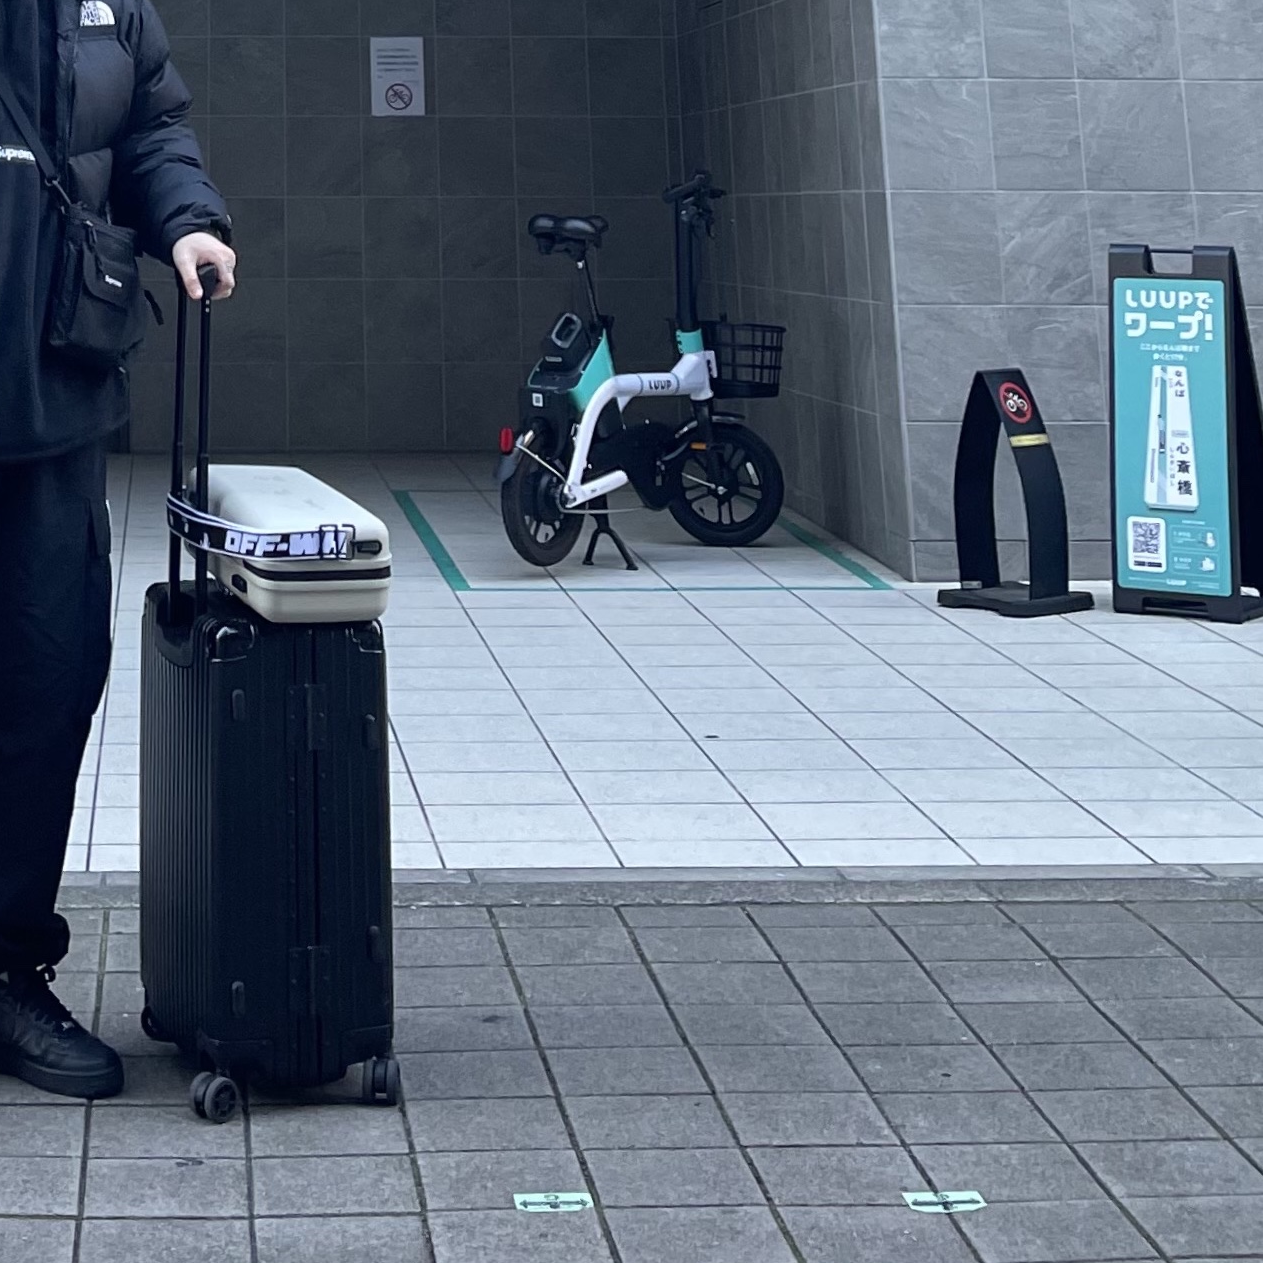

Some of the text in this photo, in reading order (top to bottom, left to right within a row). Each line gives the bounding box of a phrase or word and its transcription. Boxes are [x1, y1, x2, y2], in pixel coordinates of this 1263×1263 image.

[1125, 289, 1214, 310] LUUPで
[1124, 310, 1213, 341] ワープ!
[648, 379, 672, 390] LUUP
